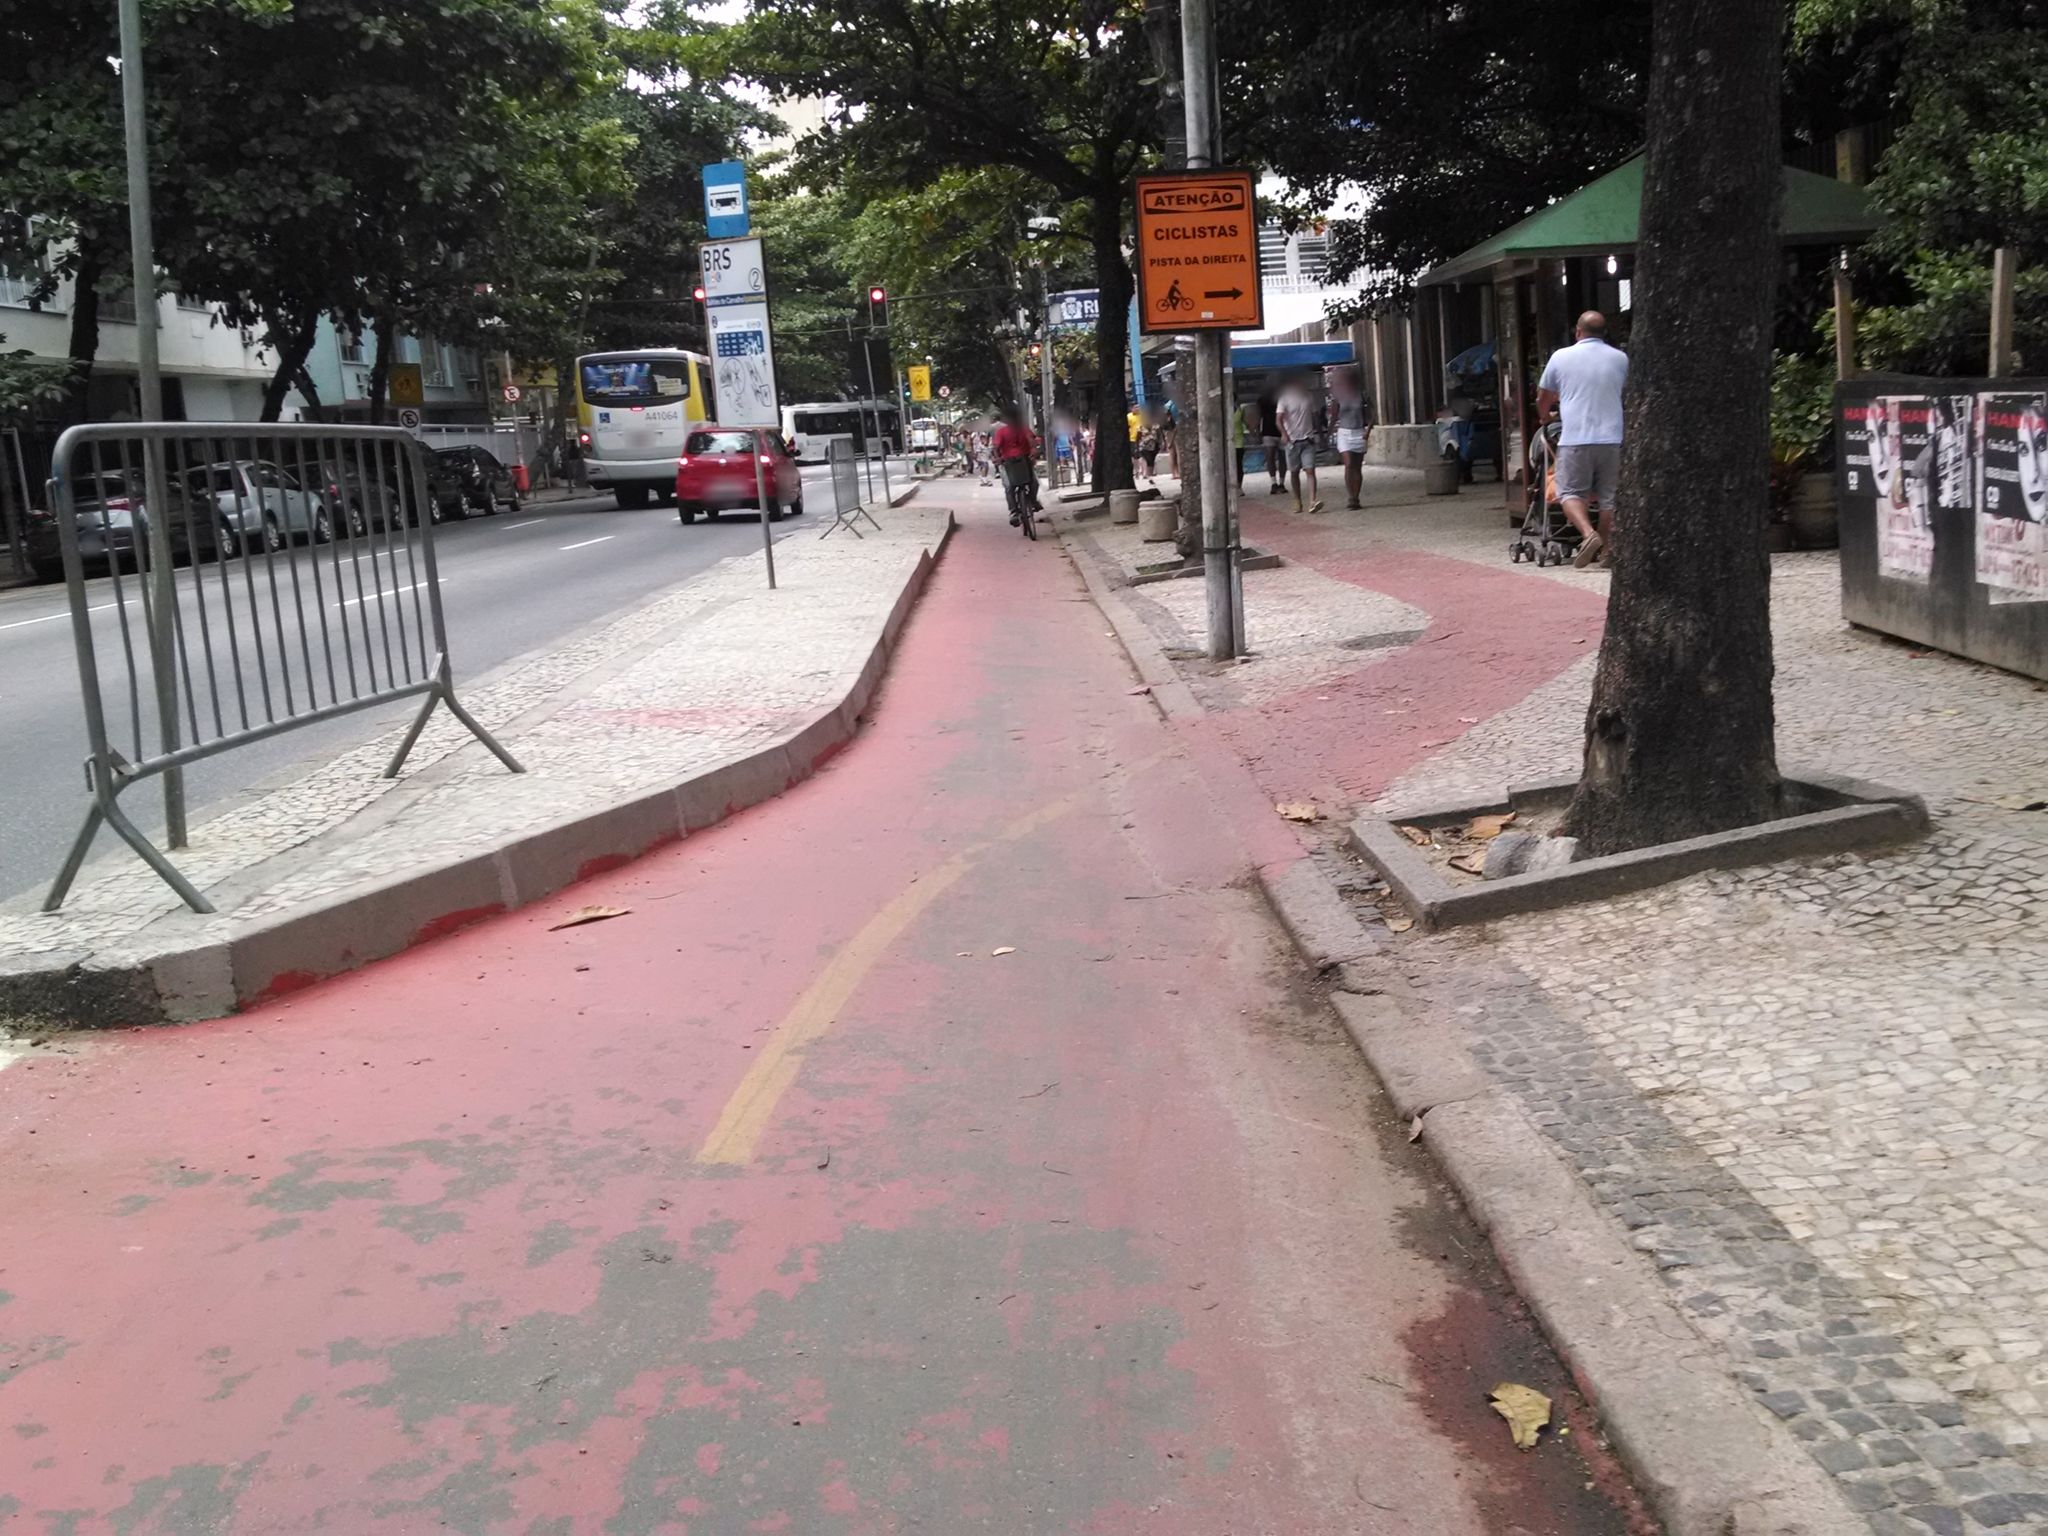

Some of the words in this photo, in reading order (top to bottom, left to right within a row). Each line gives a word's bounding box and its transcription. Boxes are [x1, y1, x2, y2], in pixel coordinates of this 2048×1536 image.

[1154, 191, 1234, 207] ATENÇÃO
[1154, 225, 1238, 241] CICLISTAS
[703, 247, 732, 272] BRS
[1150, 257, 1182, 267] PISTA
[1184, 256, 1200, 266] DA
[1202, 254, 1247, 265] DIREITA
[1083, 299, 1100, 314] RI
